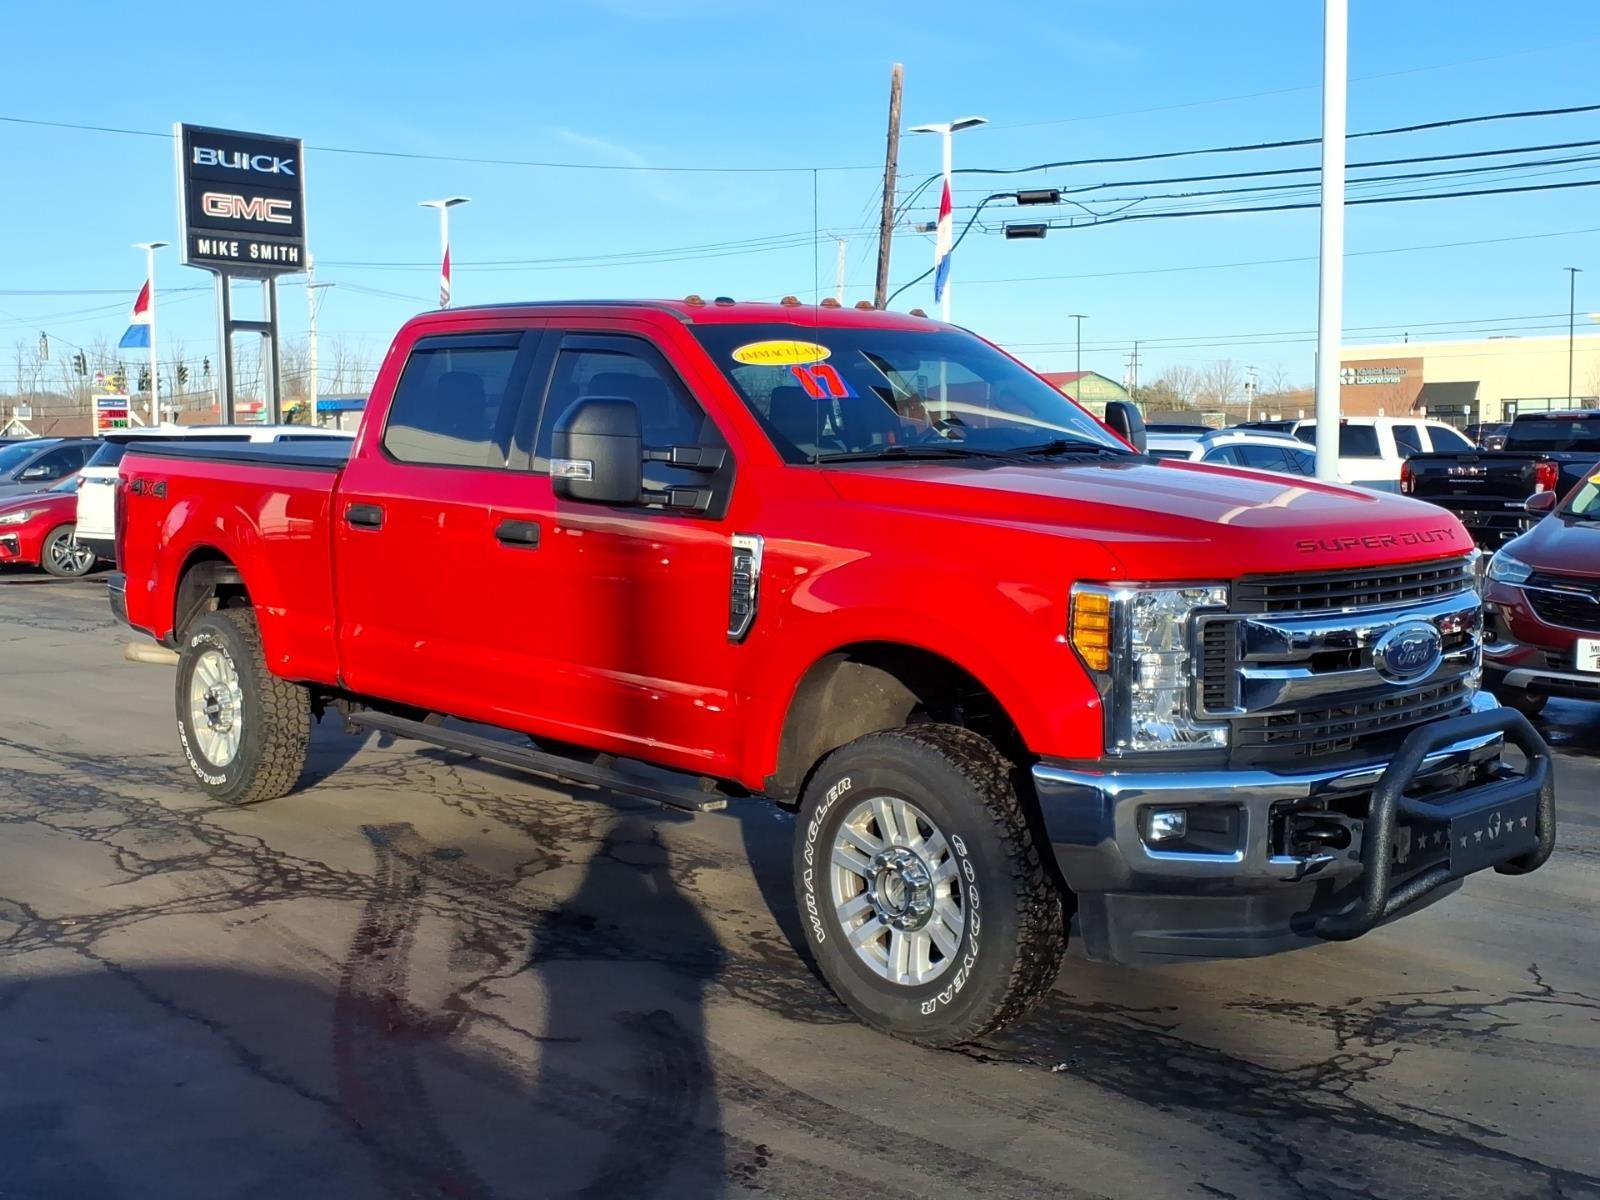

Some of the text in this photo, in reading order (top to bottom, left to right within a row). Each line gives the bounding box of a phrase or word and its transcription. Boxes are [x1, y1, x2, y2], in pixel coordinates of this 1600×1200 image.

[193, 146, 295, 175] BUICK
[202, 192, 292, 224] GMC
[198, 240, 298, 262] MIKE SMITH
[1296, 529, 1455, 552] SUPER DUTY
[1397, 639, 1431, 665] Ford
[803, 777, 852, 943] WRANGLER
[921, 834, 981, 1015] GOODYEAR
